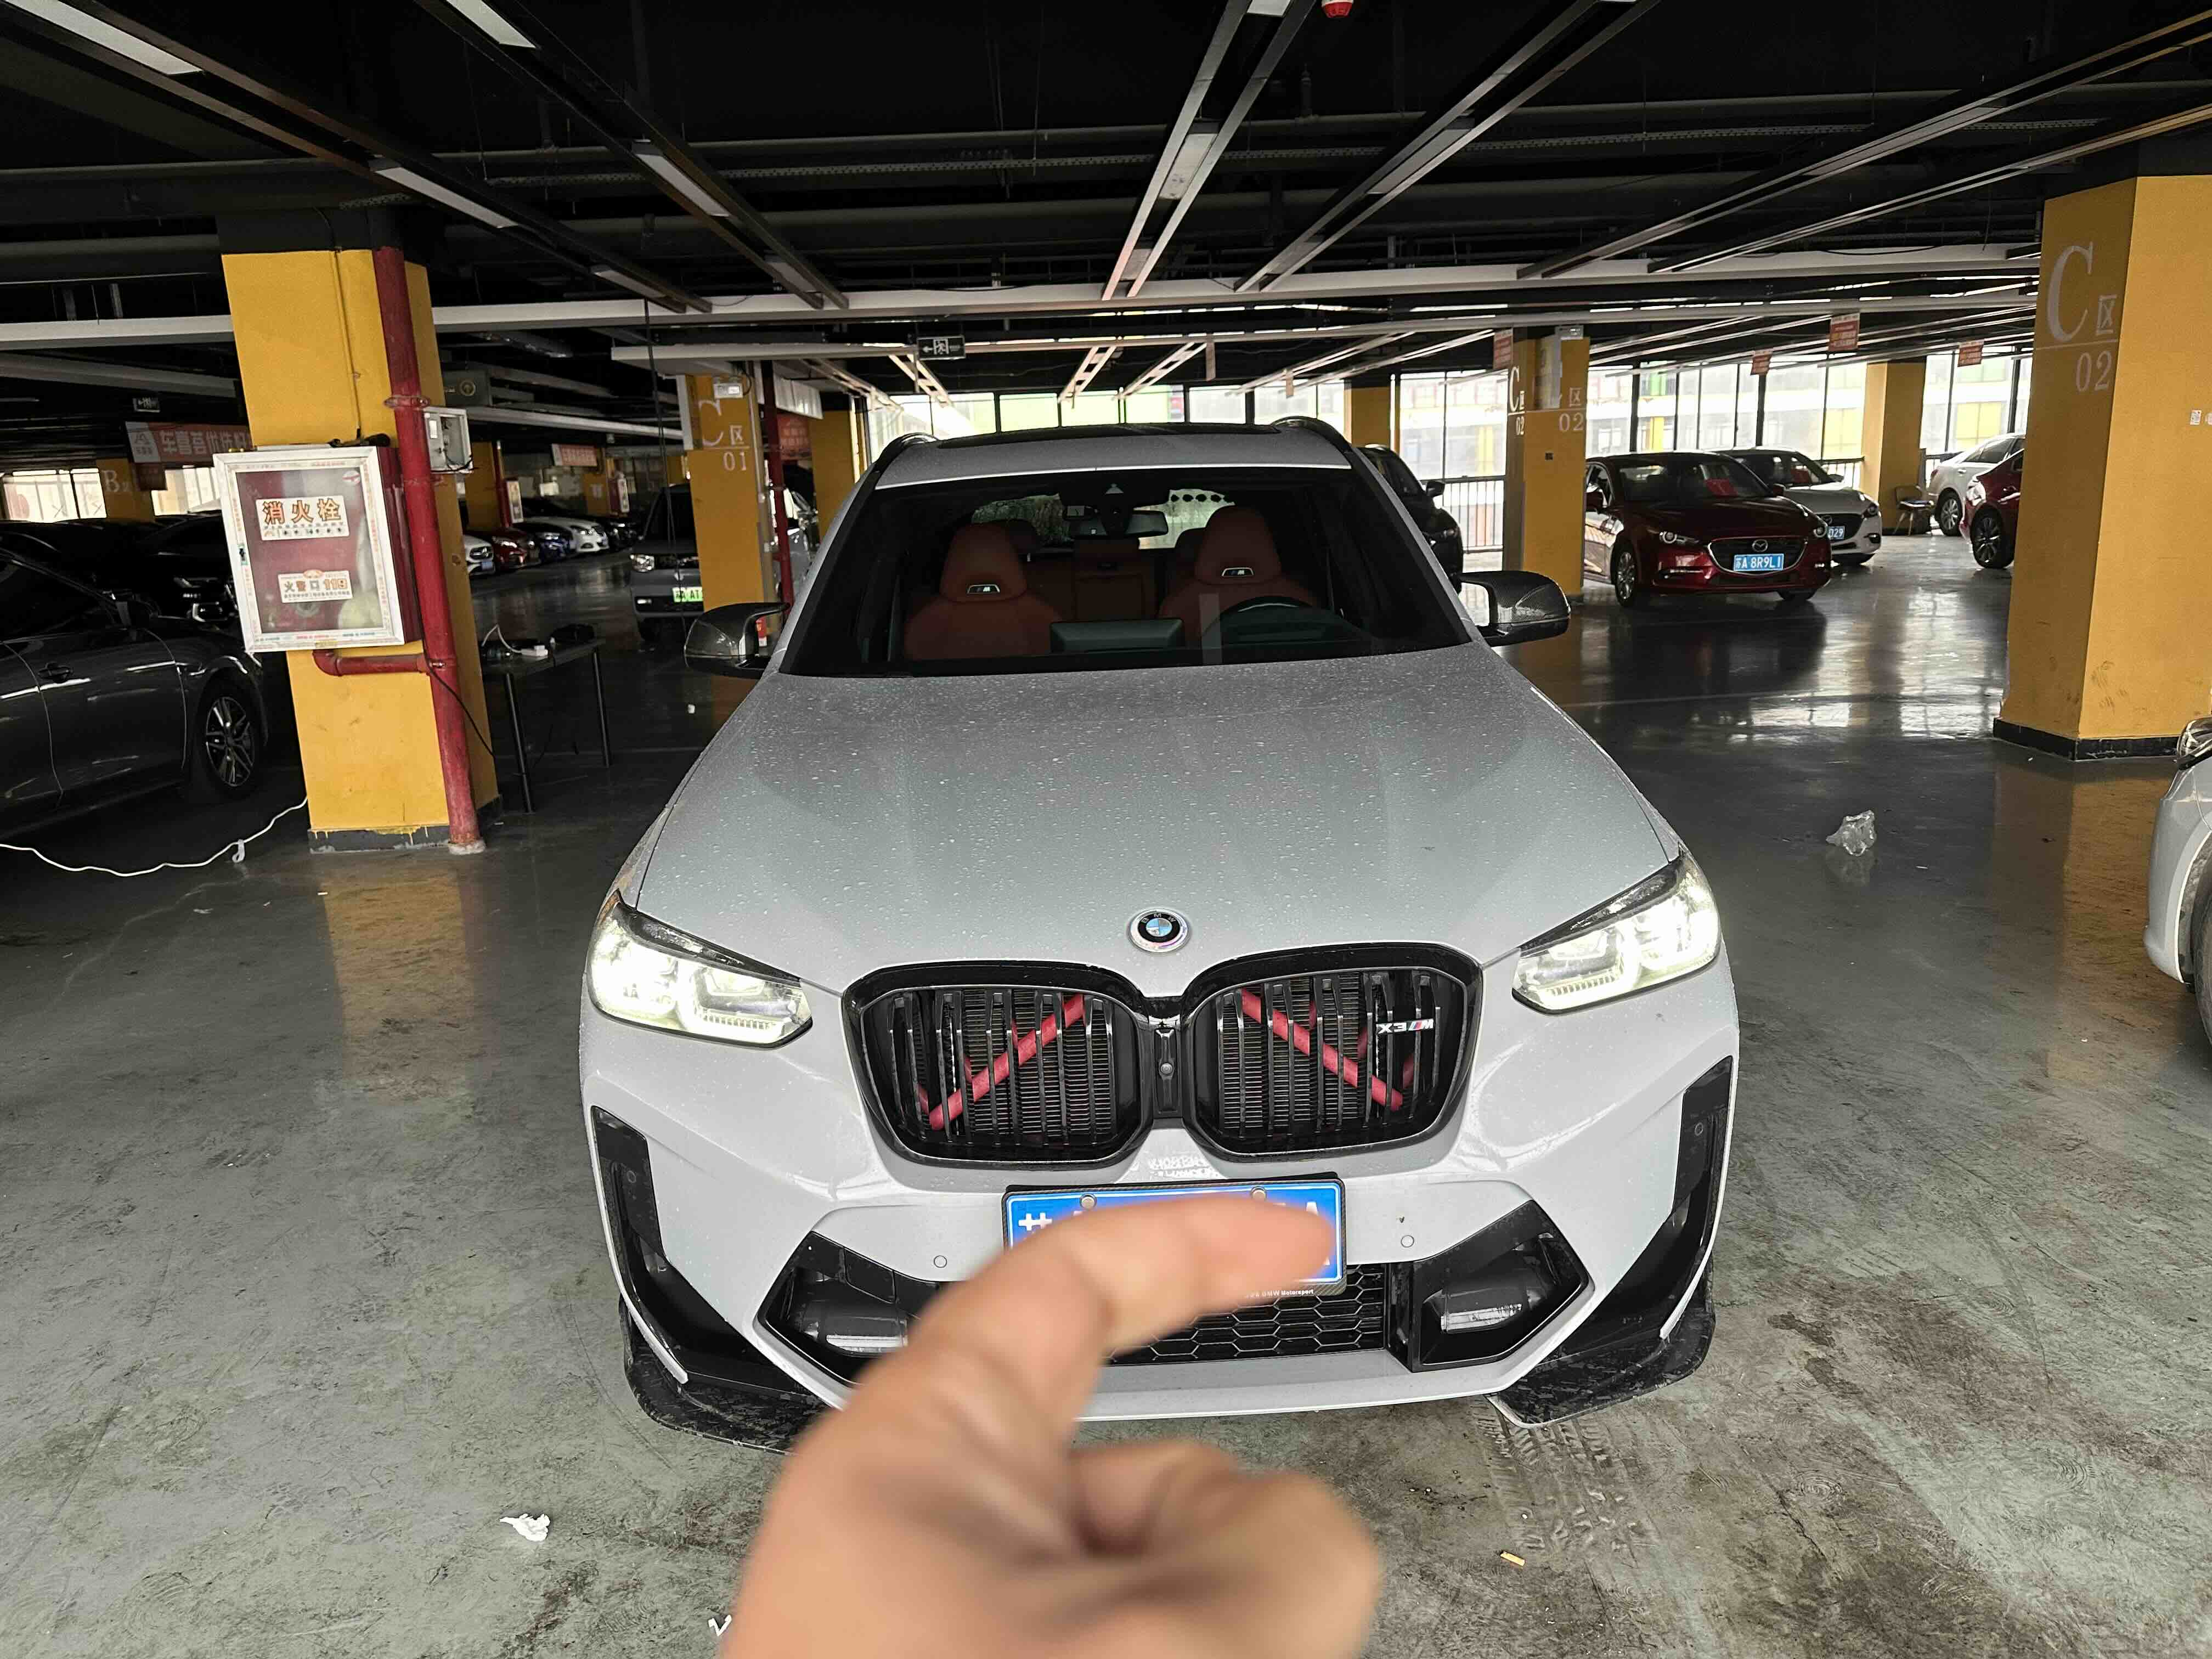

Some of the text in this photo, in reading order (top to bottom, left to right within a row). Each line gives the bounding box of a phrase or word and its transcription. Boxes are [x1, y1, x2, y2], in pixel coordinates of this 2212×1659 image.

[2076, 351, 2111, 392] 02
[1559, 413, 1583, 432] 02
[723, 452, 747, 472] 01
[263, 498, 341, 525] 消火栓
[1141, 913, 1177, 923] BMW
